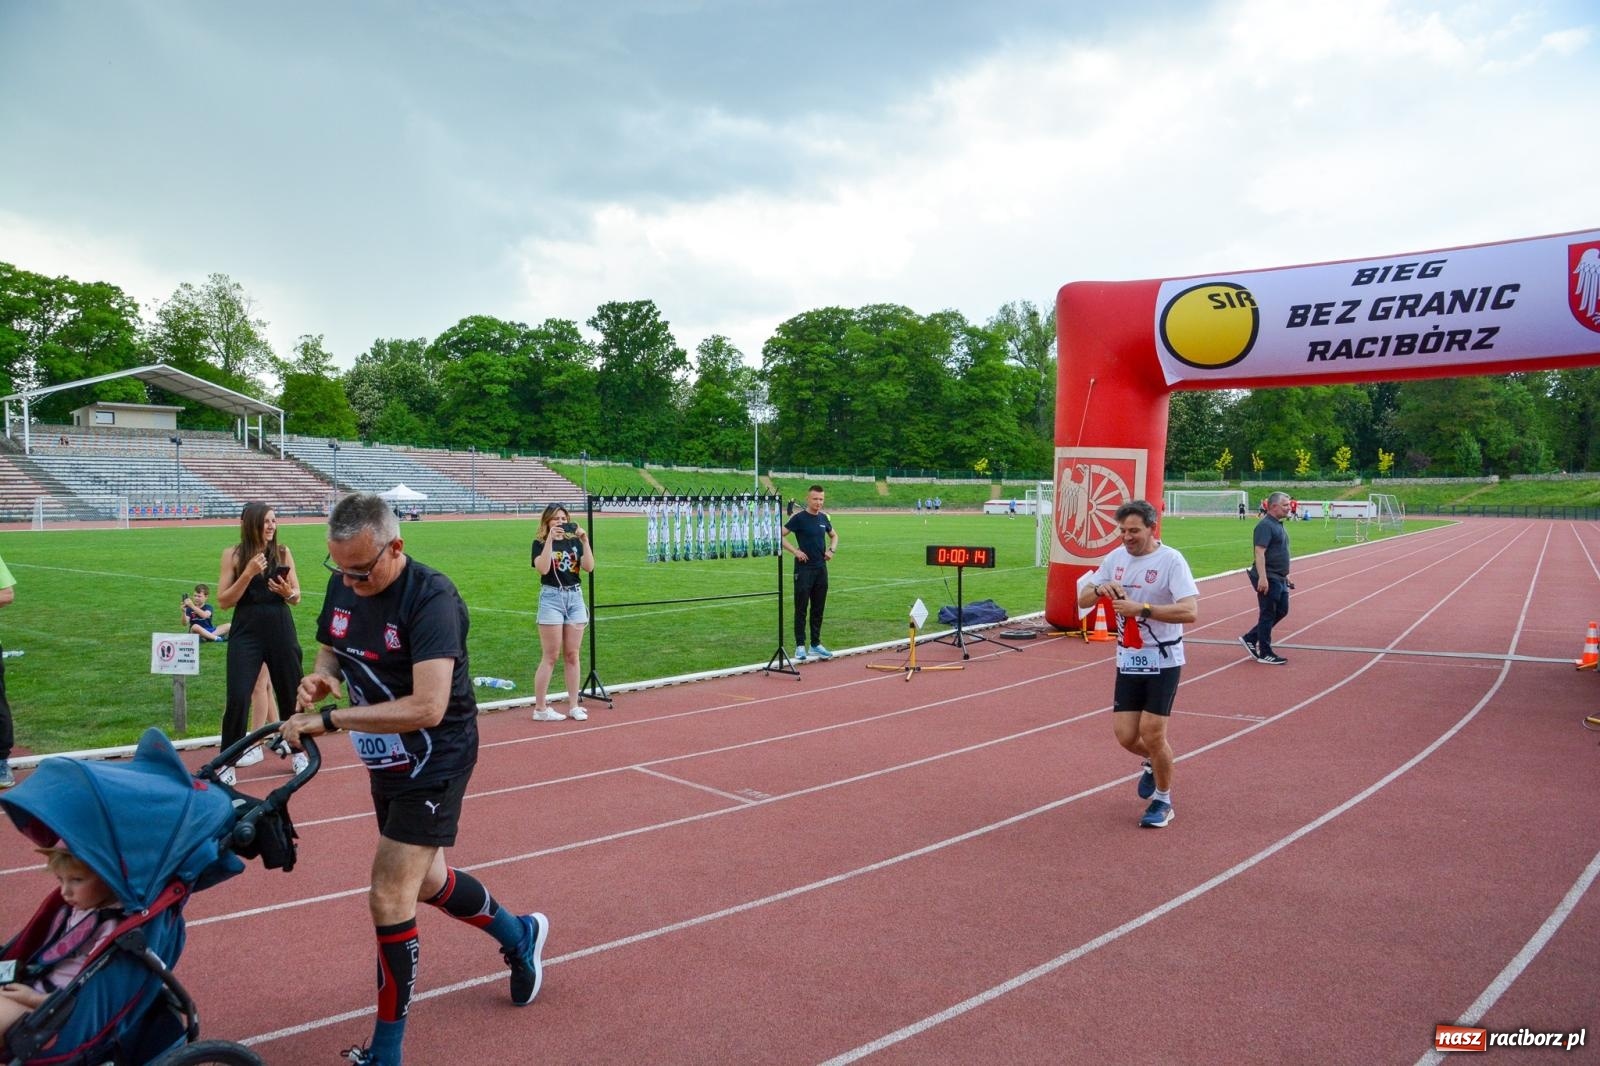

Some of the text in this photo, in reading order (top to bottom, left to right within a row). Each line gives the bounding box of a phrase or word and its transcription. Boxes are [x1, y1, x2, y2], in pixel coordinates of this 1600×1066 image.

[1351, 259, 1448, 286] BIEG
[1208, 290, 1257, 309] SIR
[1286, 283, 1520, 329] BEZ GRANIC
[1307, 324, 1500, 362] RACIBÓRZ
[1130, 655, 1149, 666] 198
[358, 737, 387, 755] 200
